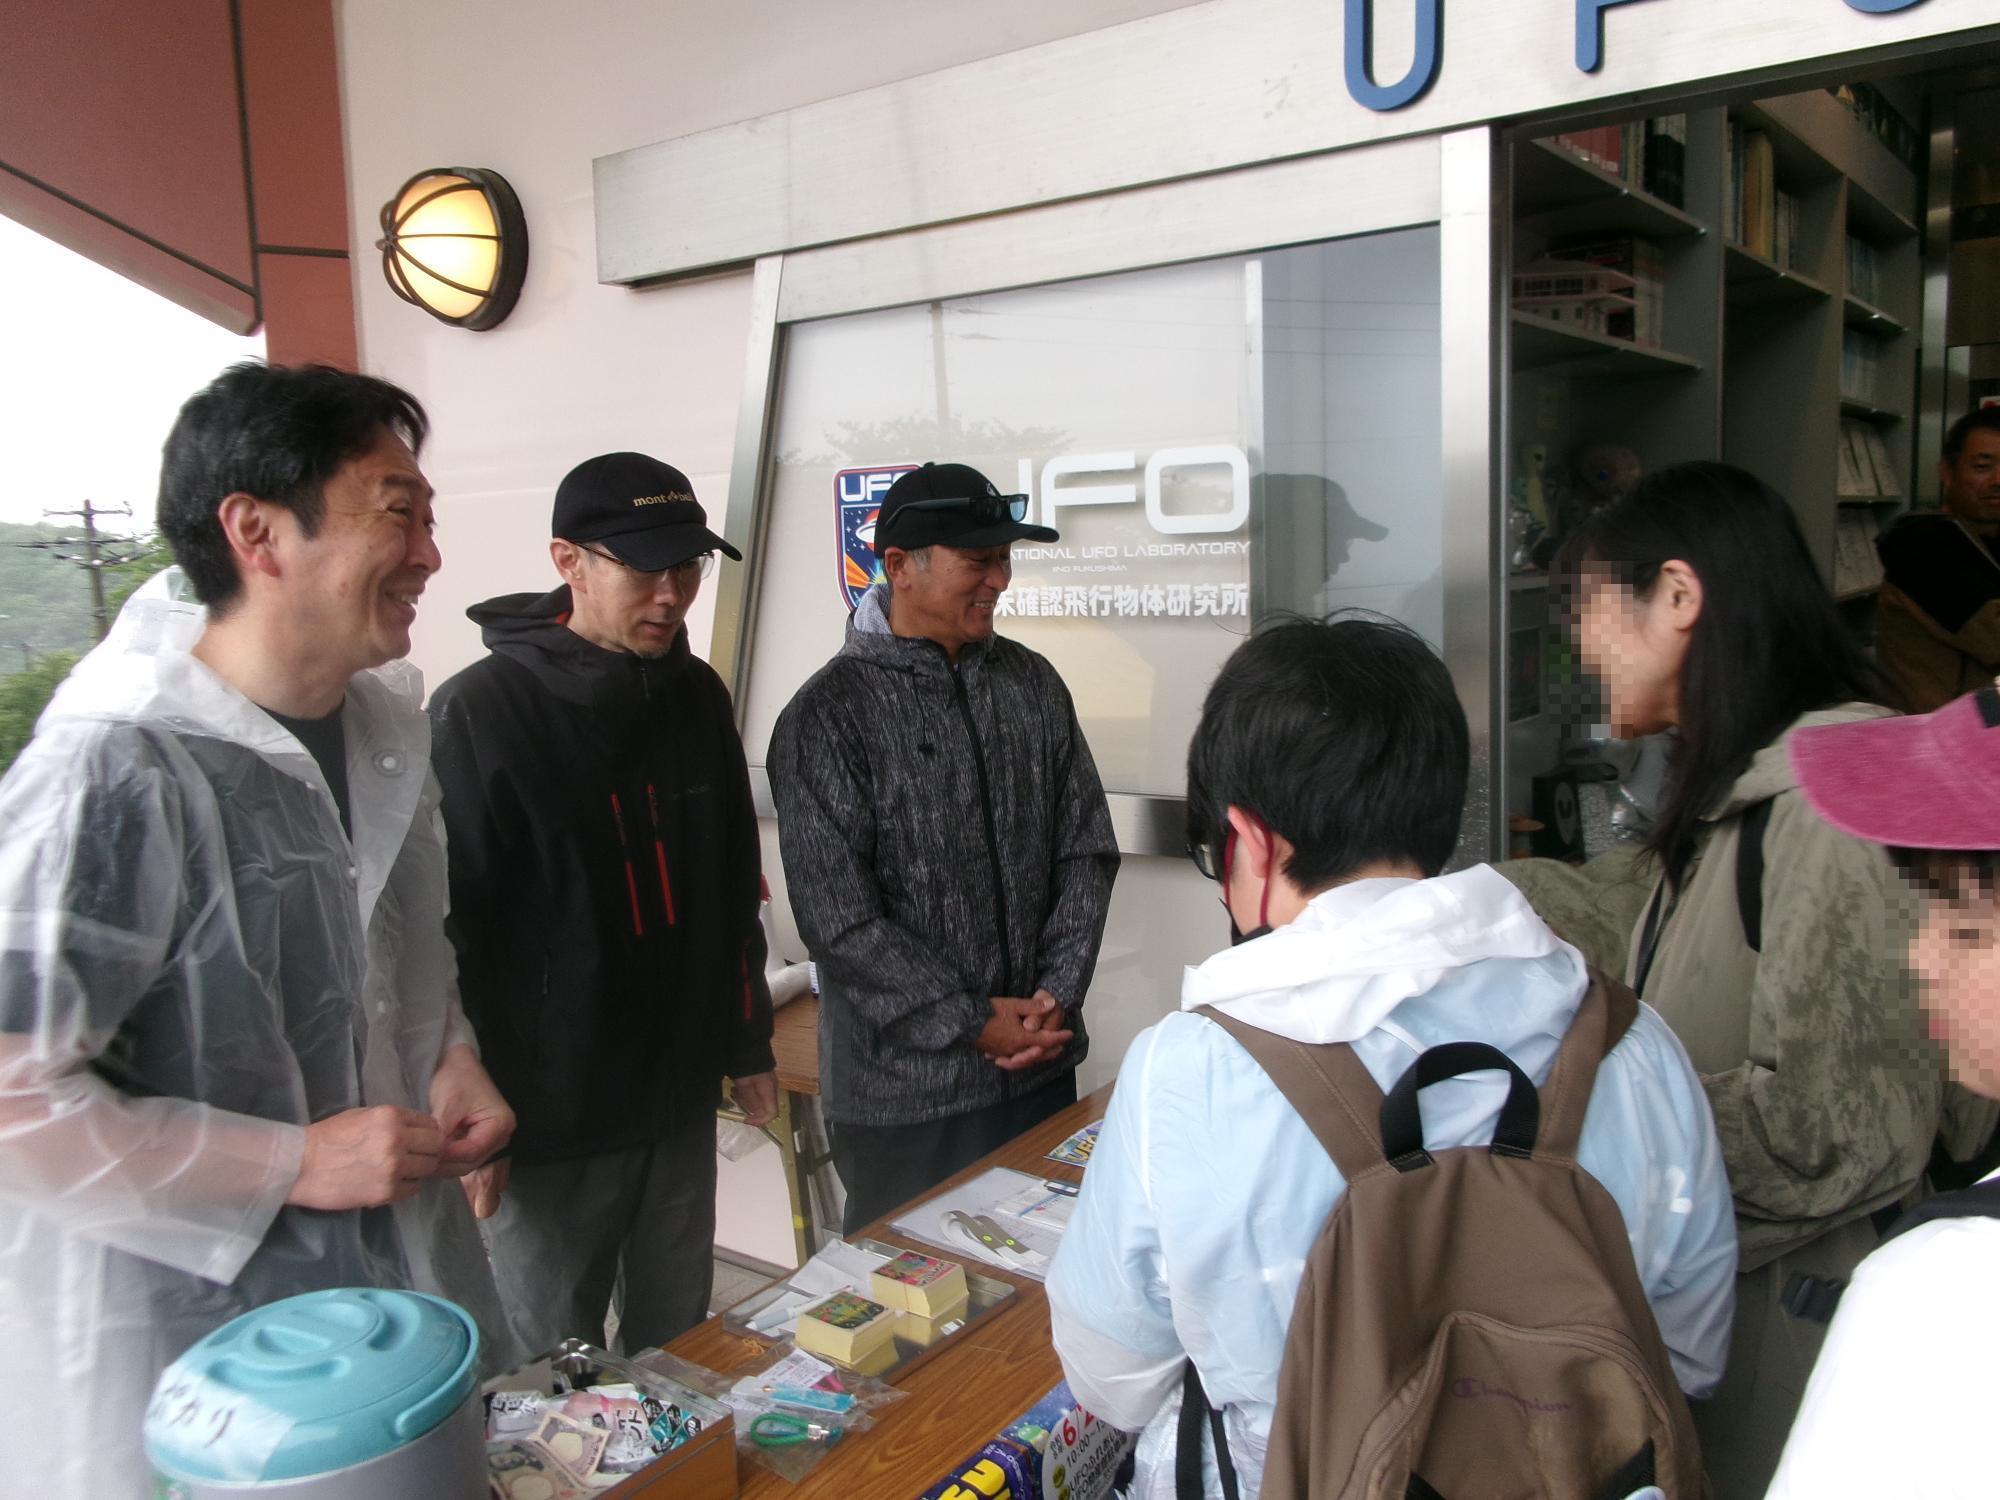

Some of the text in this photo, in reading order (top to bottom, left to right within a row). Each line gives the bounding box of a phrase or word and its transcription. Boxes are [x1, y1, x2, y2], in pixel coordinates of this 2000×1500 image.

[633, 494, 667, 507] mont
[1018, 445, 1250, 534] FO
[1082, 545, 1118, 559] UFO
[1124, 541, 1250, 557] LABORATORY
[993, 582, 1248, 617] 未確認飛行物体研究所
